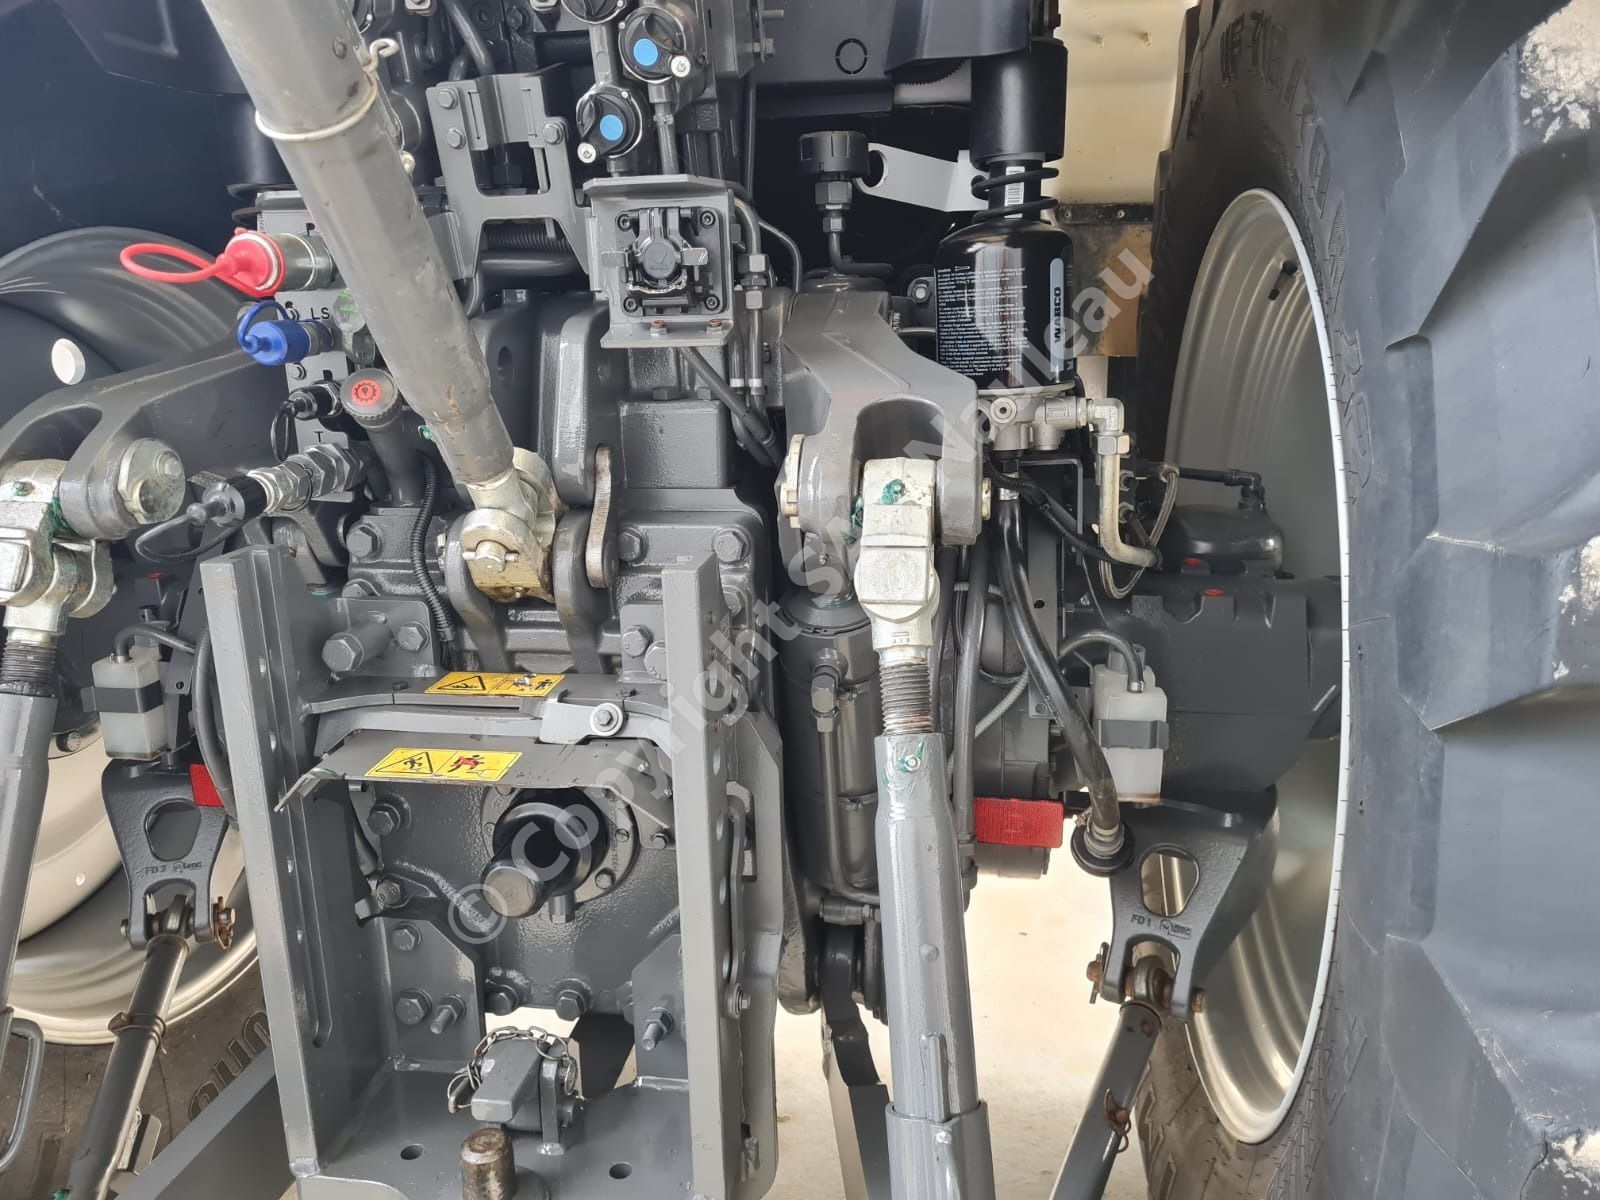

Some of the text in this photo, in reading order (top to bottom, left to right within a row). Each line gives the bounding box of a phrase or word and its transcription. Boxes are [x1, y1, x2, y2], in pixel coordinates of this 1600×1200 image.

[305, 222, 316, 237] P
[310, 306, 331, 320] LS
[1053, 286, 1062, 344] WABCO
[313, 430, 324, 443] T
